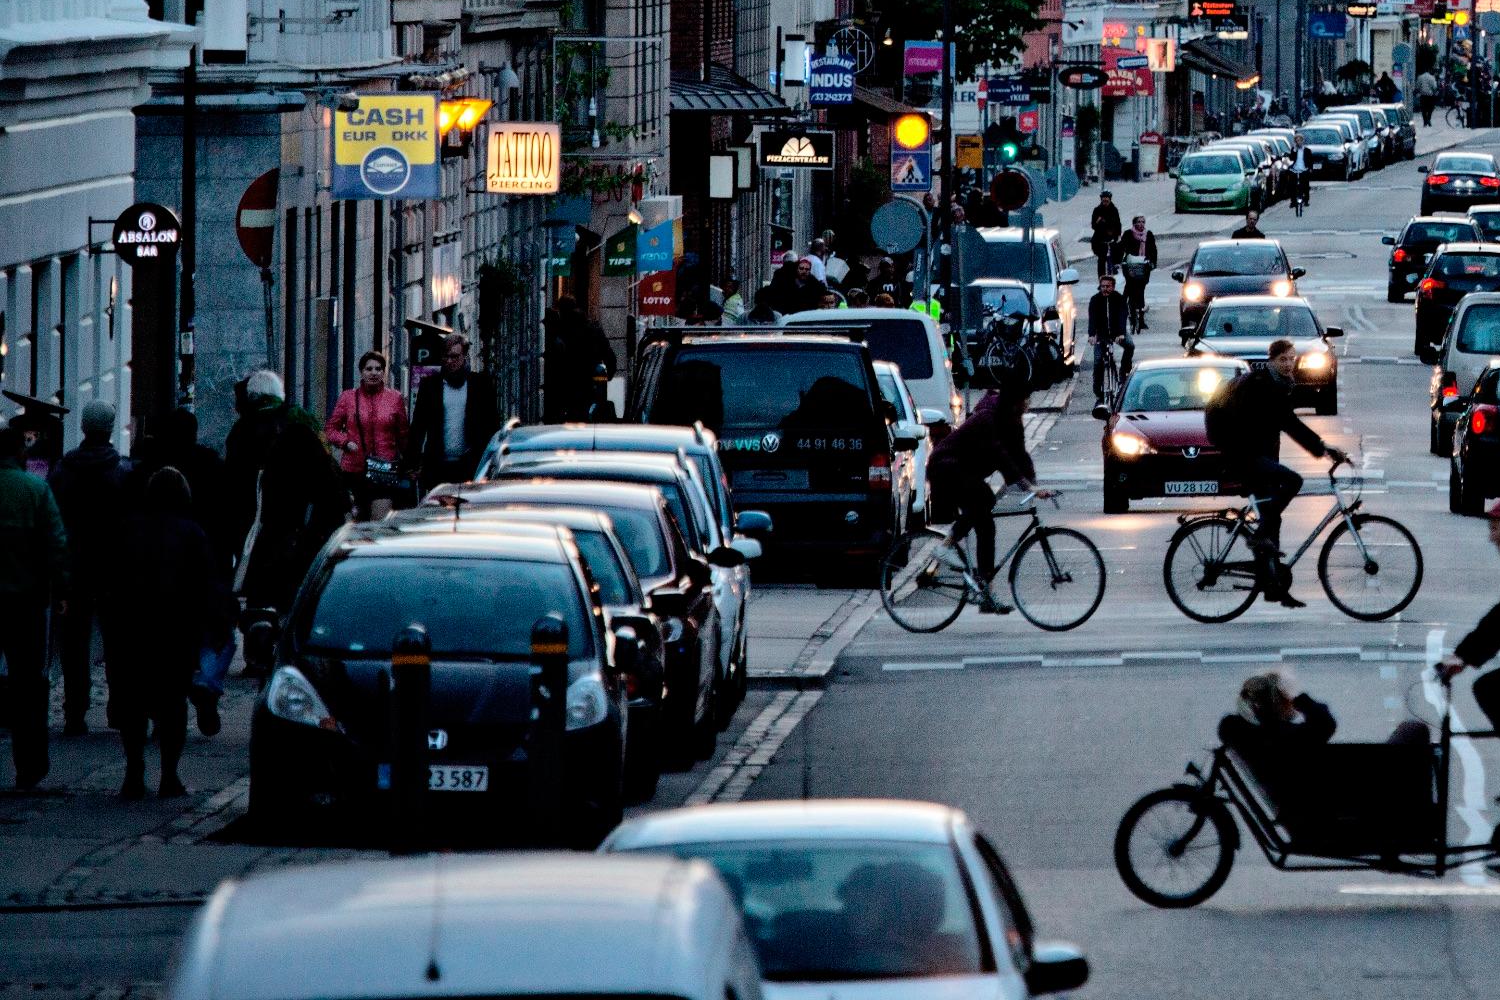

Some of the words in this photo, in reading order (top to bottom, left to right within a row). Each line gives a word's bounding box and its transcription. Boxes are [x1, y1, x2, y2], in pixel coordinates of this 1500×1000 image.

[811, 57, 853, 70] RESTAURANT
[811, 73, 852, 87] INDUS
[347, 109, 424, 125] CASH
[343, 131, 376, 141] EUR
[392, 131, 427, 141] DKK
[492, 131, 552, 179] TATTOO
[491, 181, 552, 189] PIERCING
[118, 228, 177, 243] ABSALON
[136, 245, 158, 257] BAR
[609, 258, 632, 266] TIPS
[643, 297, 671, 305] LOTTO
[418, 349, 430, 362] P
[734, 439, 760, 450] VVS
[797, 439, 811, 449] 44
[814, 439, 826, 449] 91
[1166, 483, 1181, 492] VU
[1184, 483, 1196, 492] 28
[1199, 482, 1217, 492] 120
[450, 770, 484, 788] 587
